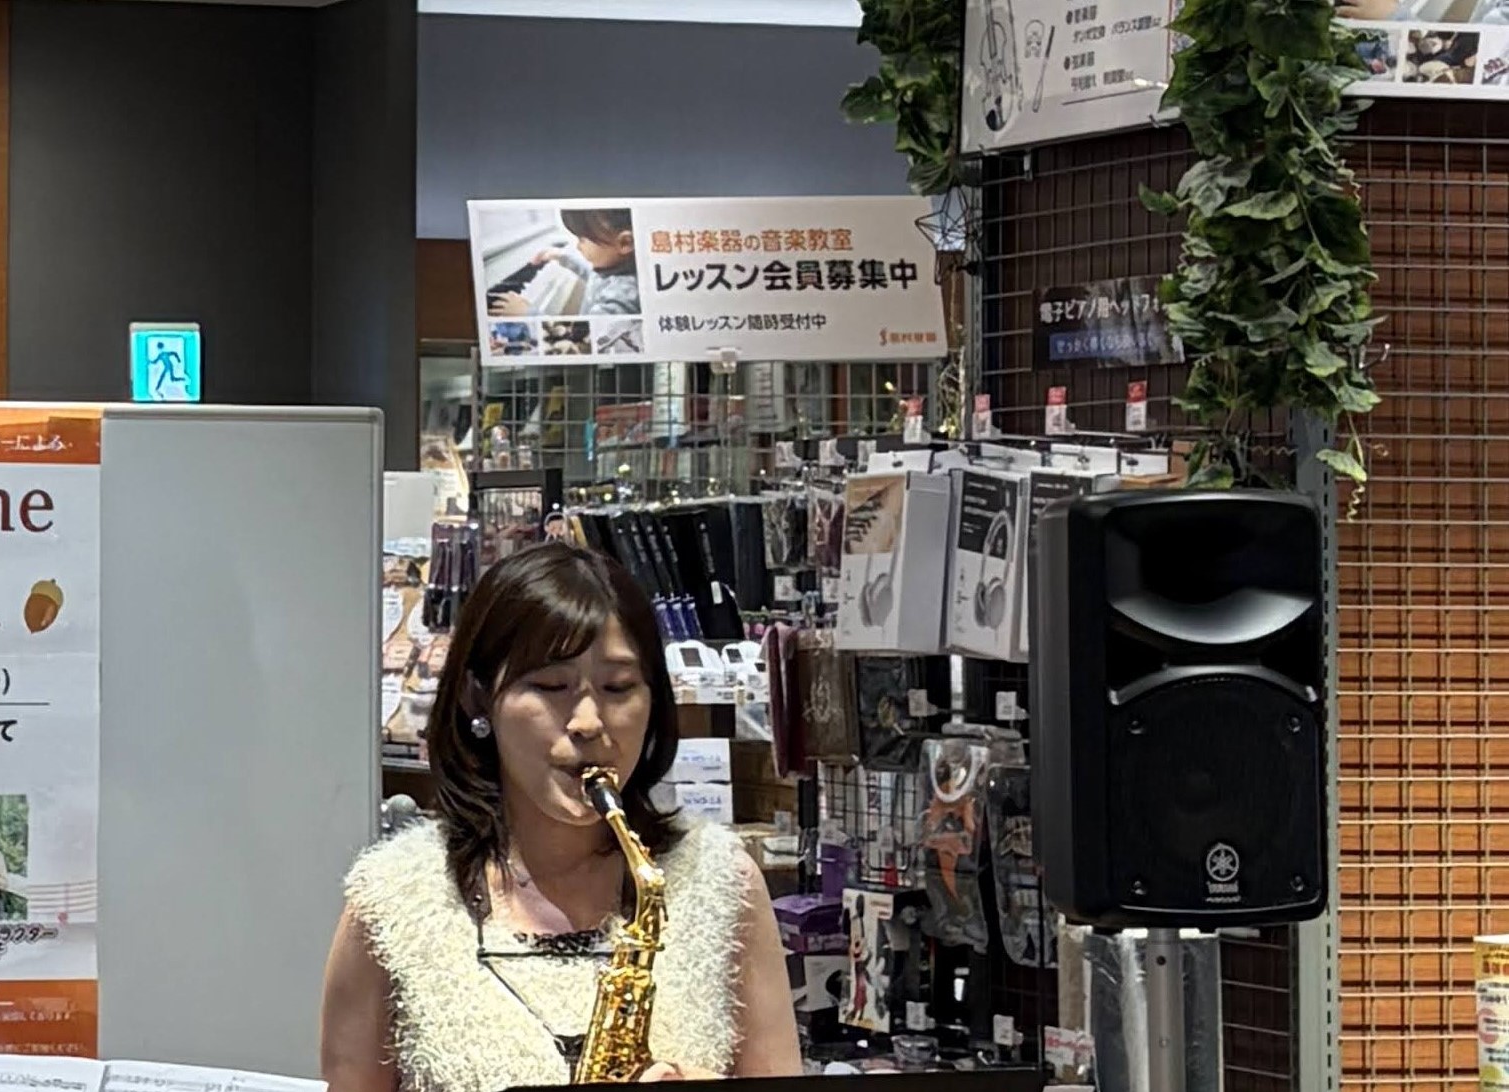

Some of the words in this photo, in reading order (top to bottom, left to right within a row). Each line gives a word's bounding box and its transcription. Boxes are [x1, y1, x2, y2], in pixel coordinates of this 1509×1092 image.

[651, 228, 854, 254] 島村楽器の音楽教室
[654, 259, 918, 292] レッスン会員募集中
[658, 313, 827, 333] 体験レッスン随時受付中
